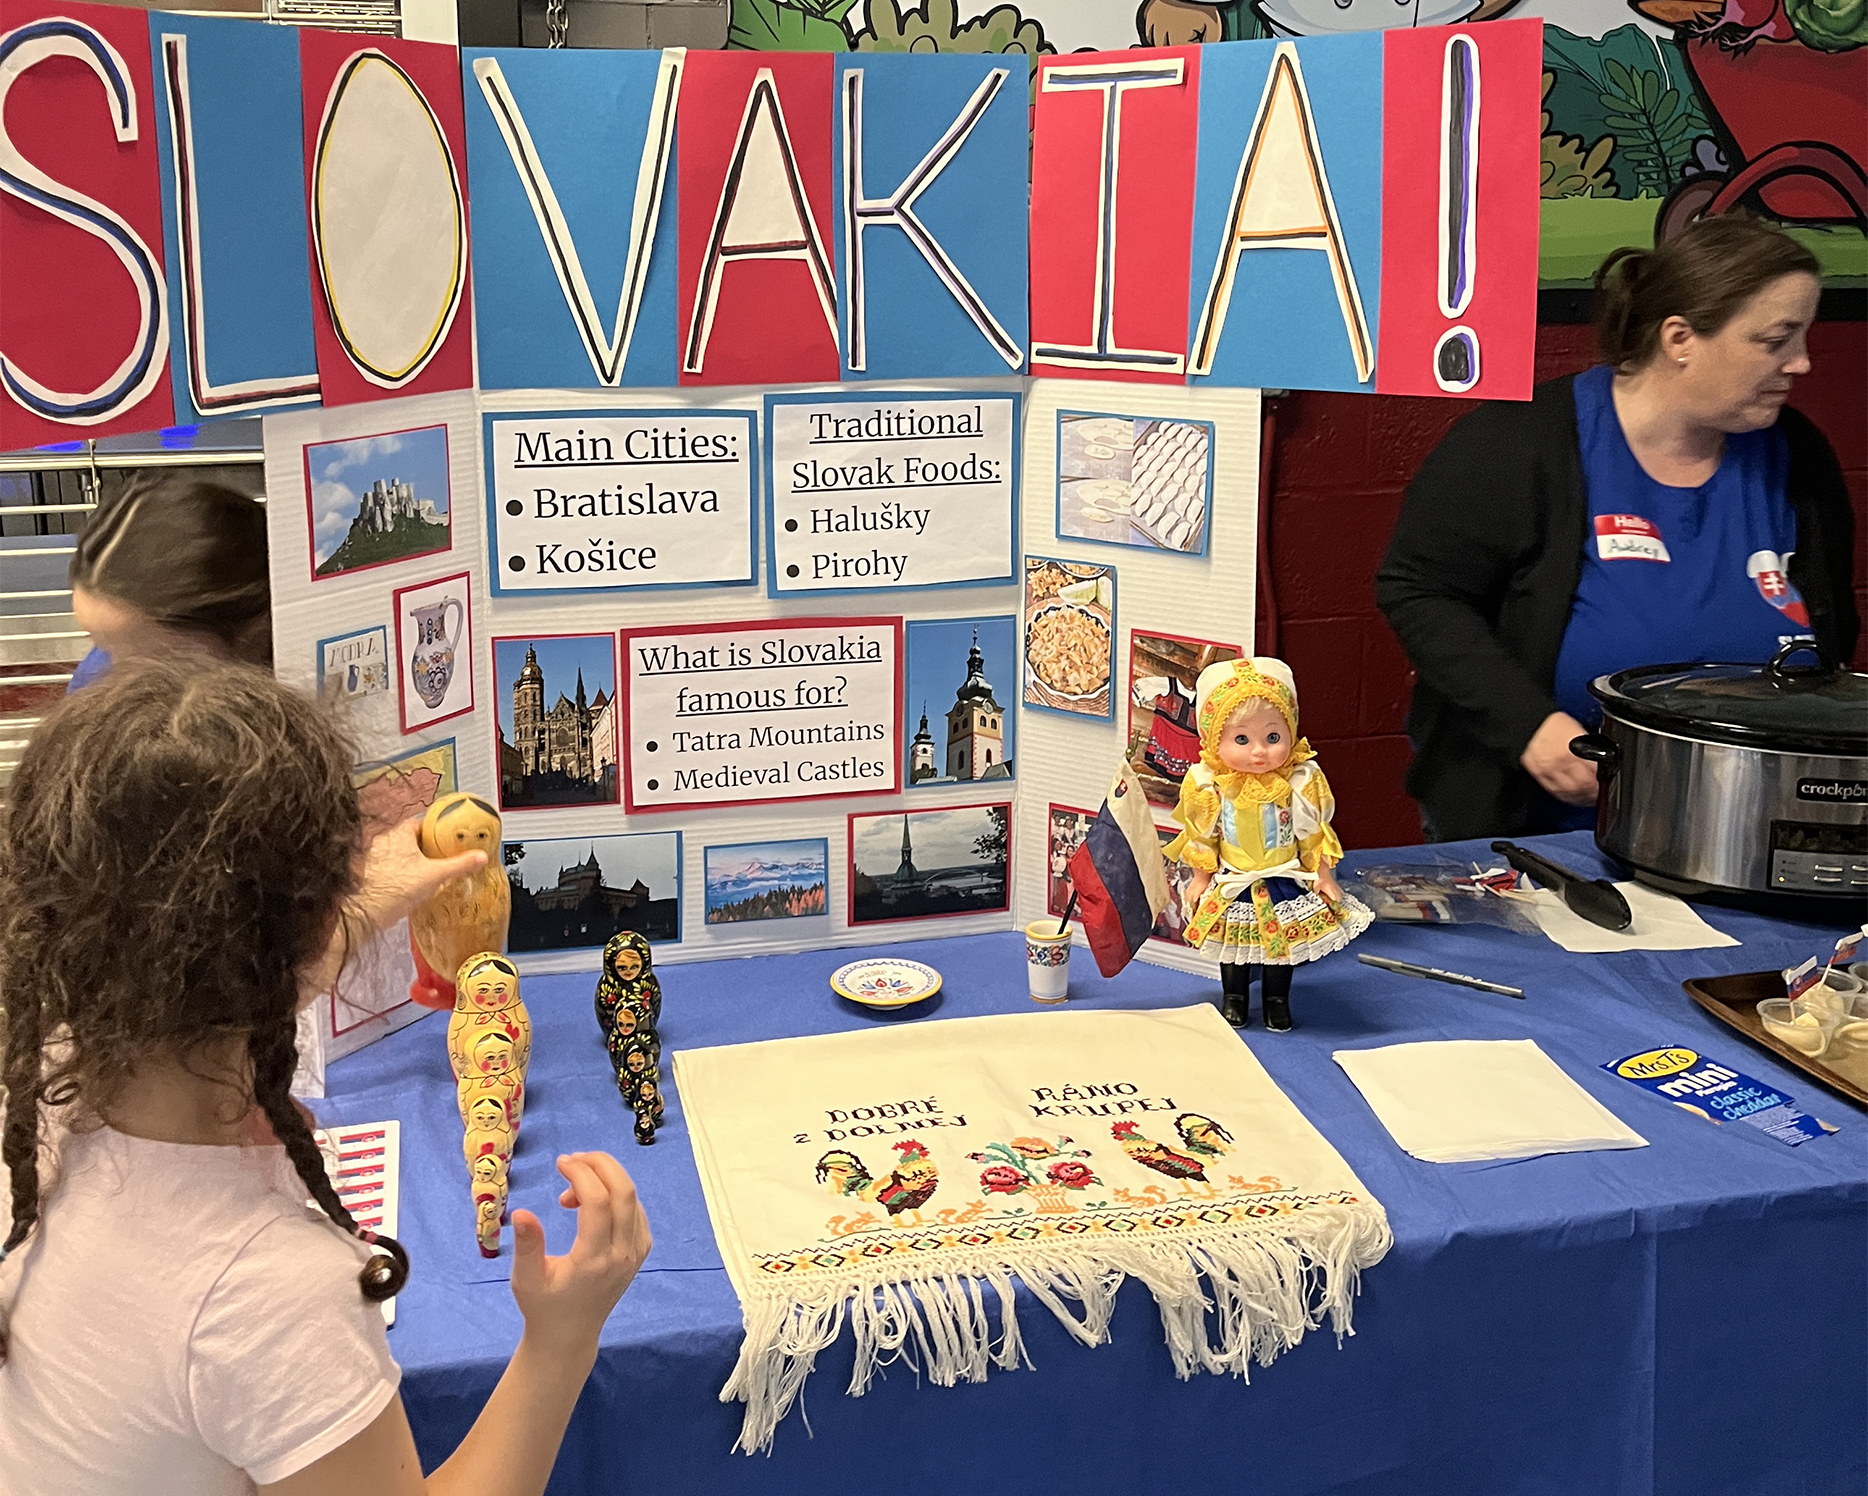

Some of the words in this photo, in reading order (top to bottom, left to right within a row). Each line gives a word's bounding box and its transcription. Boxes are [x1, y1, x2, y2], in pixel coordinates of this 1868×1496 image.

[0, 16, 1480, 425] SLOVAKIA!
[809, 405, 983, 439] Traditional
[514, 429, 614, 463] Main
[625, 427, 738, 460] Cities:
[792, 457, 895, 488] Slovak
[903, 453, 1001, 483] Foods:
[533, 482, 719, 519] Bratislava
[810, 502, 931, 535] Halušky
[535, 537, 657, 574] Košice
[812, 549, 908, 581] Pirohy
[638, 645, 720, 672] What
[728, 642, 752, 667] is
[761, 635, 882, 665] Slovakia
[676, 686, 786, 713] famous
[794, 675, 848, 706] for?
[672, 729, 741, 753] Tatra
[748, 720, 885, 748] Mountains
[673, 761, 790, 791] Medieval
[797, 756, 885, 782] Castles
[1656, 1062, 1740, 1097] mini
[825, 1095, 944, 1124] DOBRÉ
[1030, 1082, 1139, 1102] RÁNO
[1710, 1087, 1763, 1109] classic
[1722, 1093, 1782, 1120] cheddar
[823, 1114, 968, 1142] DOLNEJ
[1028, 1097, 1178, 1117] KRUPEJ
